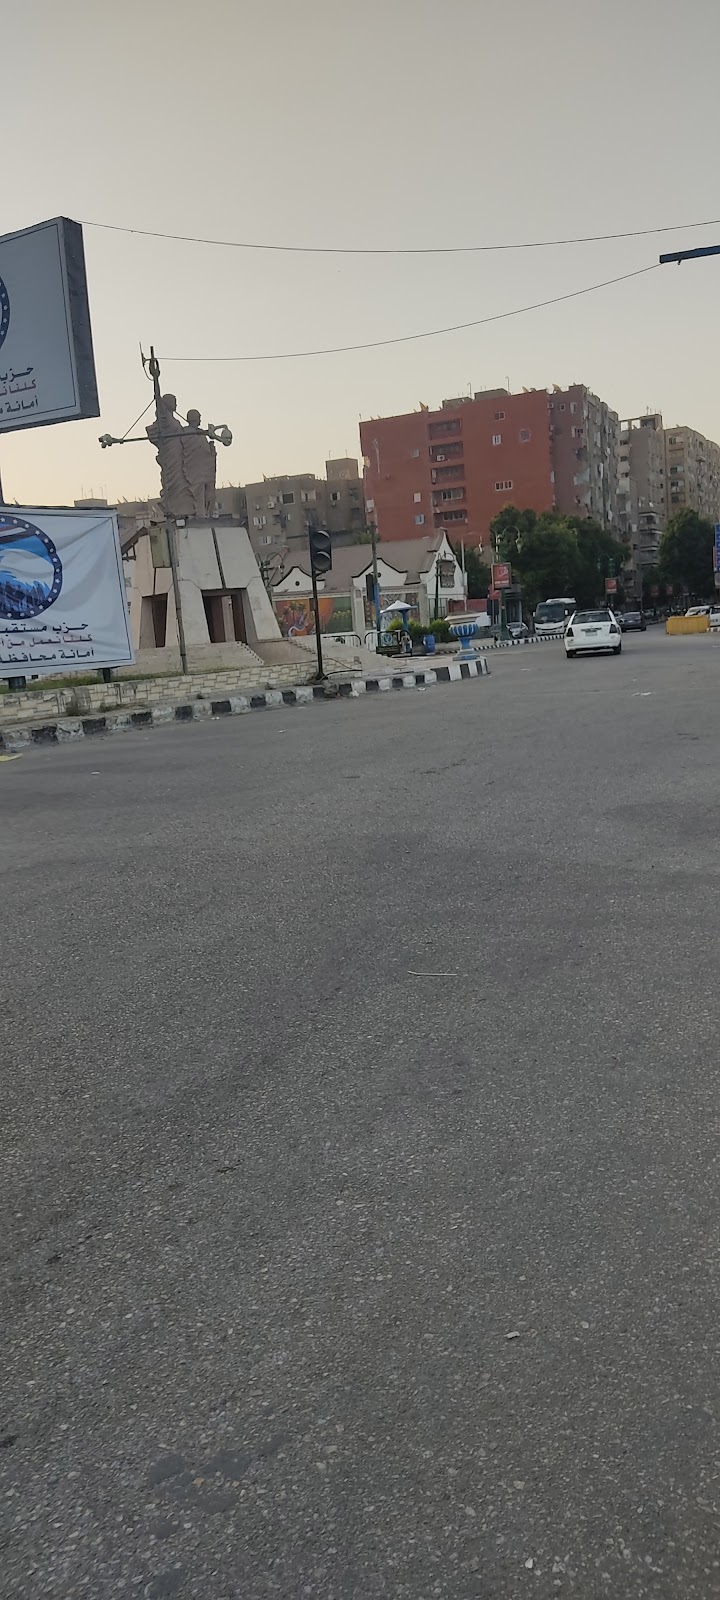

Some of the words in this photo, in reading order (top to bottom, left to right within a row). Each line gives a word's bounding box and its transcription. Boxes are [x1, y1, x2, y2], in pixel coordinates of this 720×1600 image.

[8, 379, 37, 394] كلنا
[5, 396, 39, 412] أمانة
[52, 622, 89, 634] حزب
[7, 639, 25, 649] من
[29, 635, 61, 648] نعمل
[62, 634, 93, 643] كلنا
[0, 652, 57, 664] محافظ
[58, 647, 95, 659] أمانة
